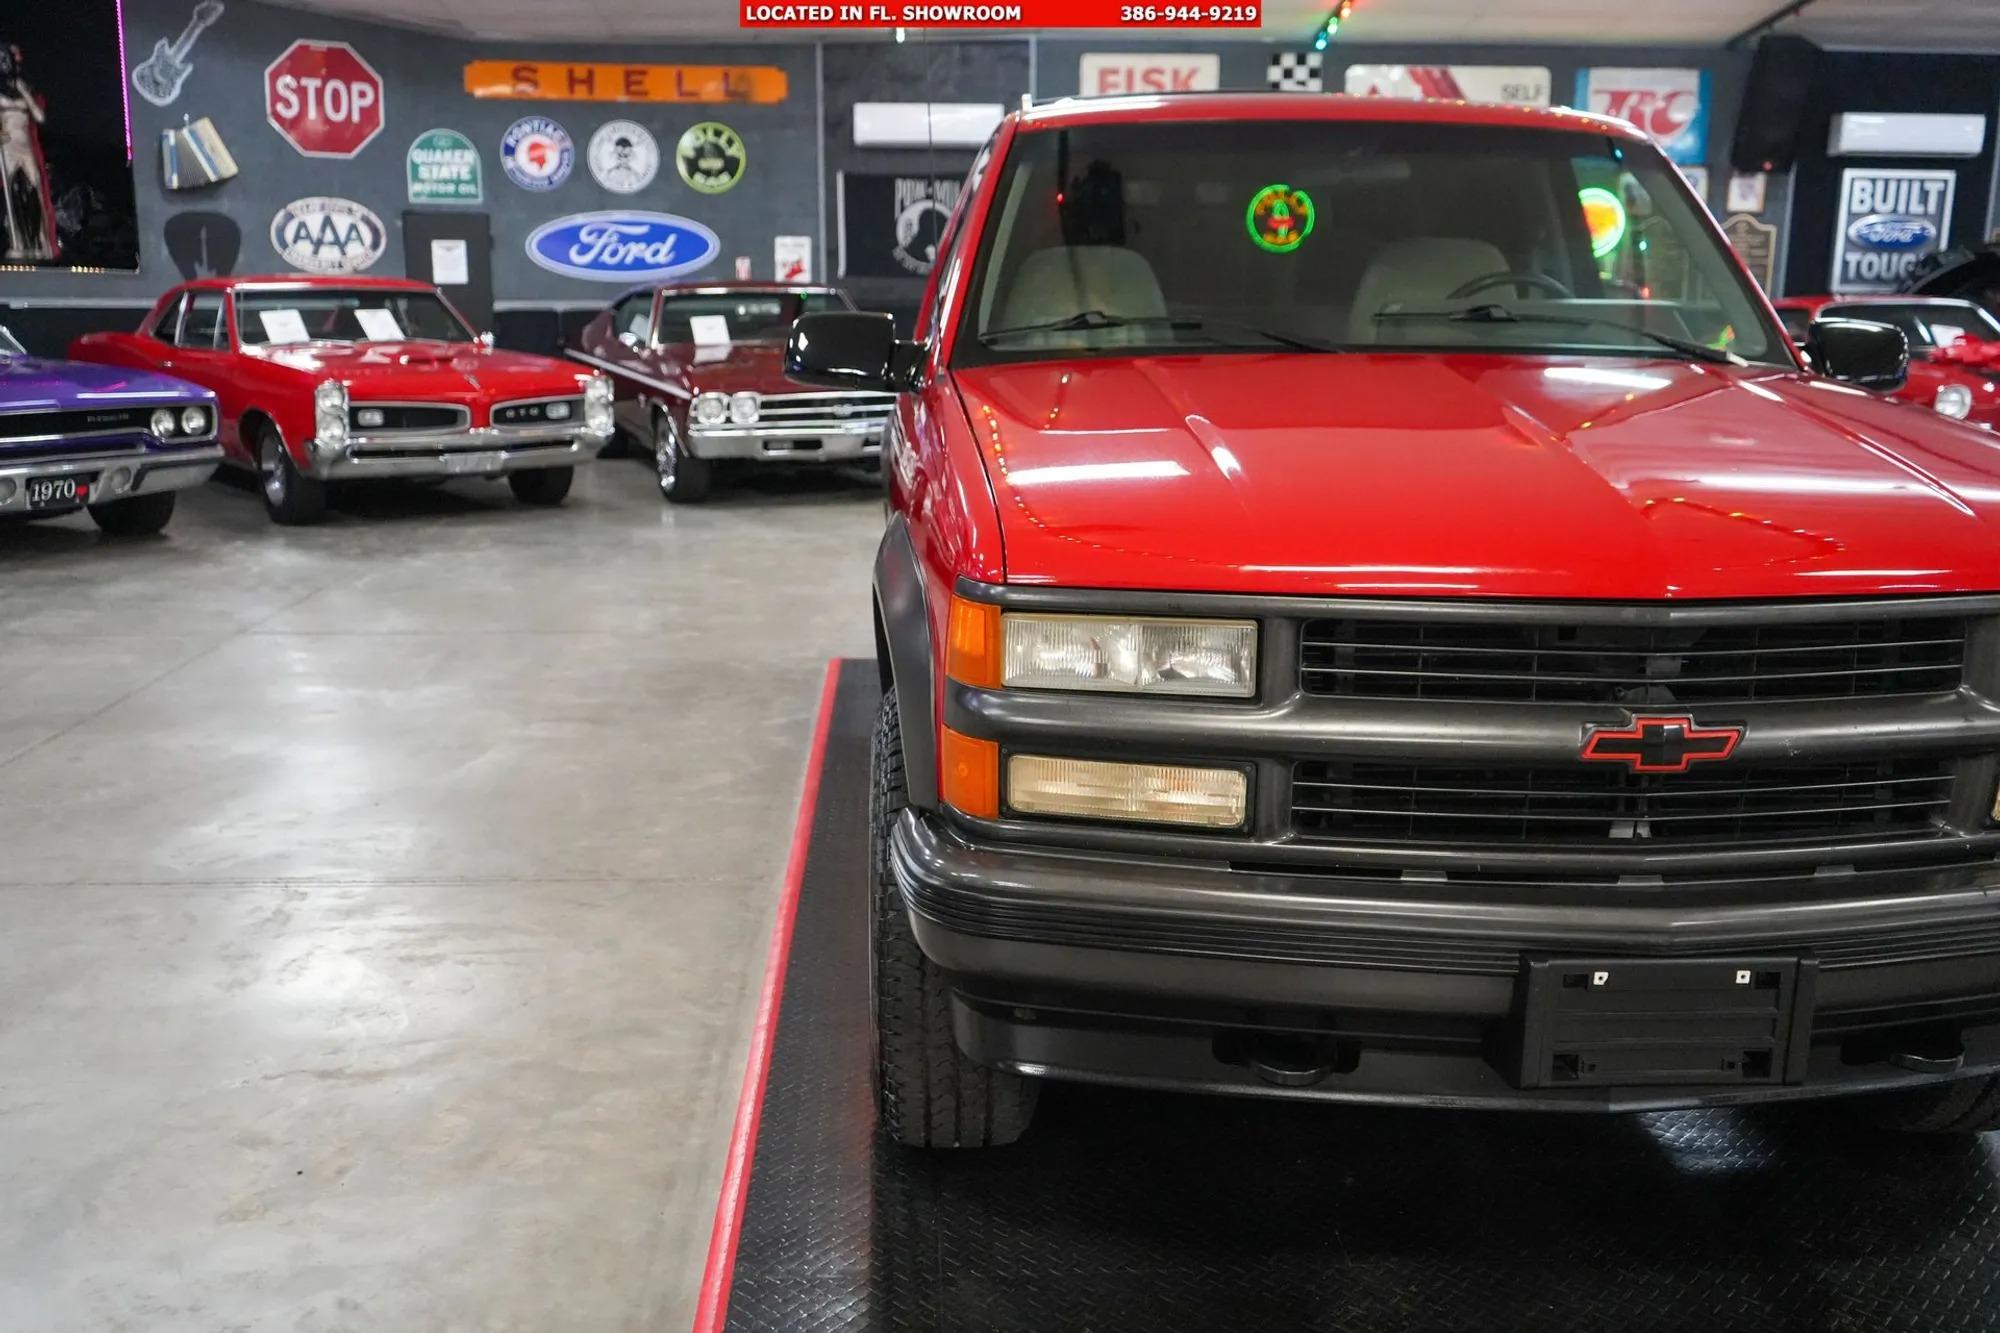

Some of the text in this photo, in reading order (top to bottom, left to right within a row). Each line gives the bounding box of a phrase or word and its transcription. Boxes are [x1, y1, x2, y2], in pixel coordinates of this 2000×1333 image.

[511, 65, 750, 98] SHELL
[1097, 66, 1200, 94] FISK
[1502, 83, 1542, 101] SELF
[275, 74, 375, 124] STOP
[505, 119, 567, 147] PONTIAC
[412, 148, 475, 165] QUAKER
[418, 164, 472, 180] STATE
[1850, 179, 1945, 214] BUILT
[293, 215, 365, 256] AAA
[569, 222, 678, 266] Ford
[1845, 252, 1922, 281] TOUG
[32, 478, 75, 502] 1970
